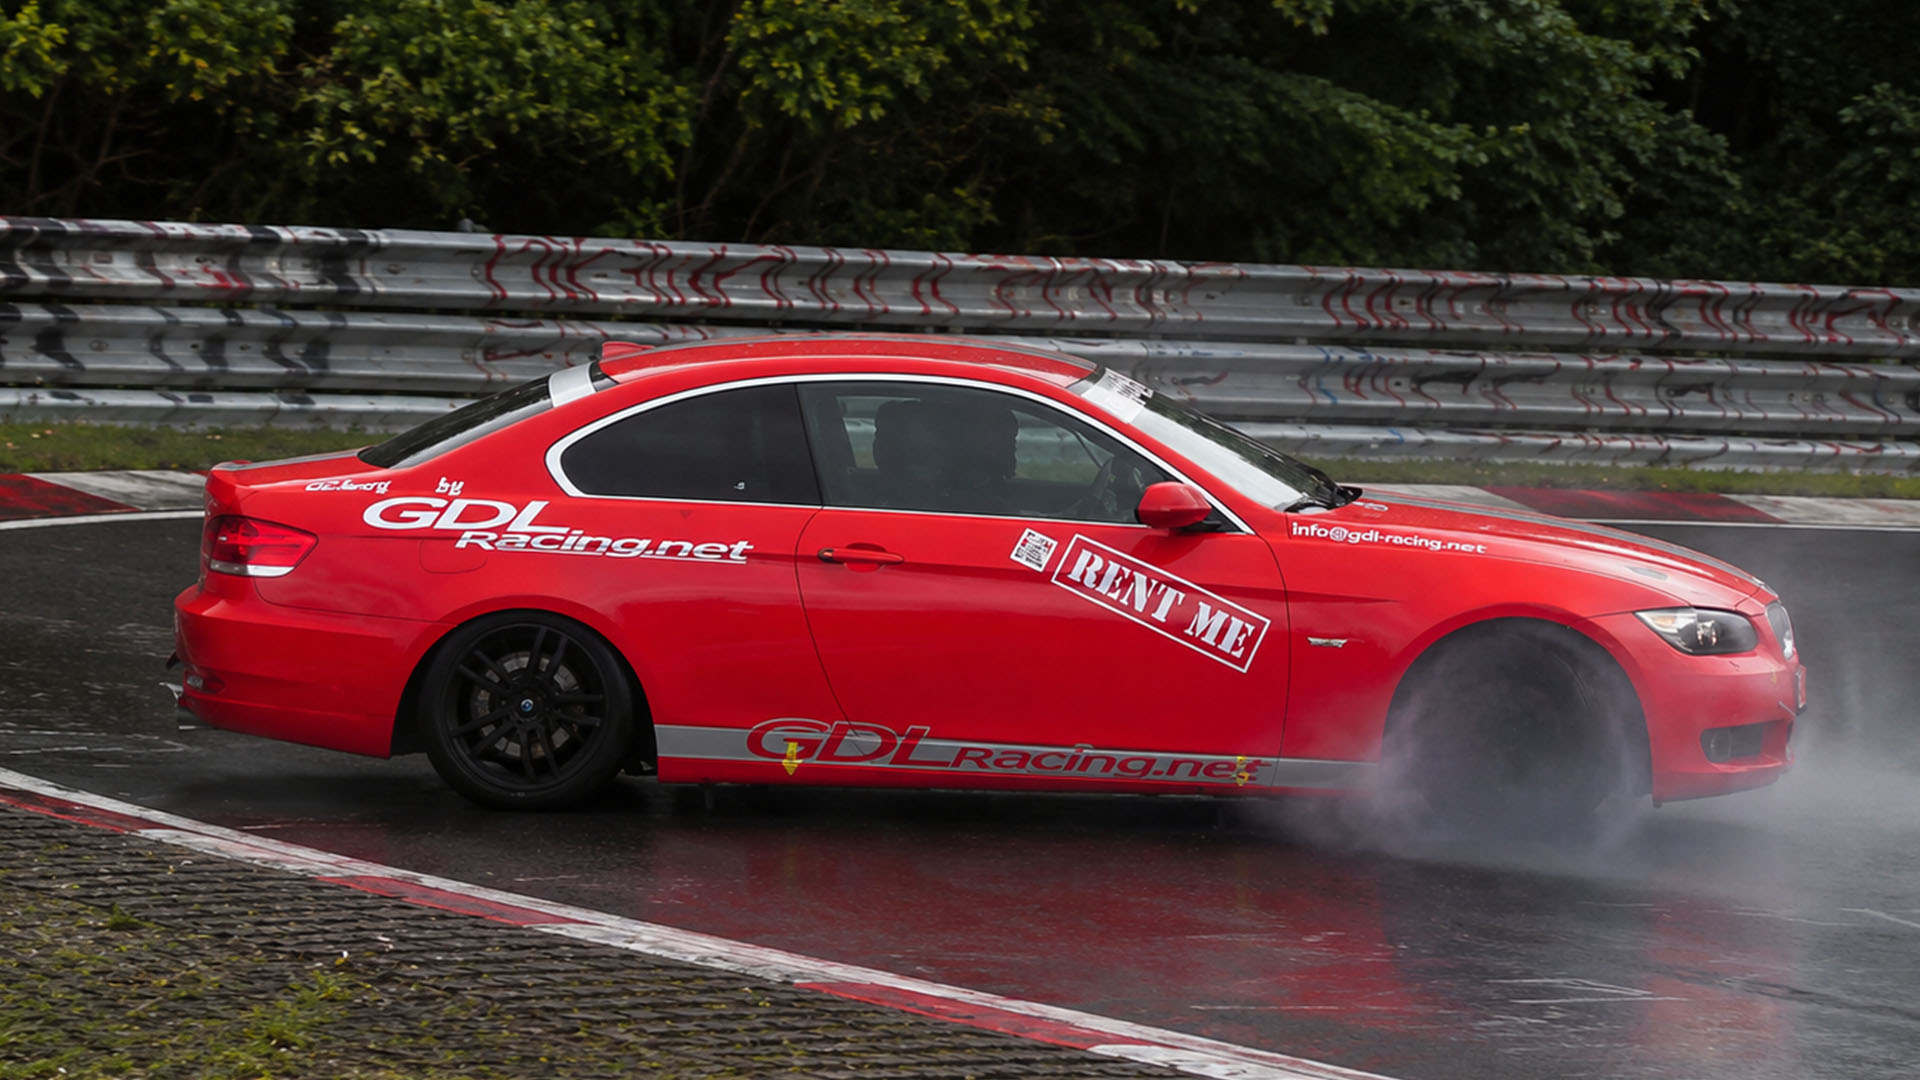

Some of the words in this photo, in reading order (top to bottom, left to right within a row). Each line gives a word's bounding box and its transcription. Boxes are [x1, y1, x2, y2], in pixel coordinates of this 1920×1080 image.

[435, 476, 464, 496] by
[363, 497, 570, 533] GDL
[455, 530, 754, 563] Racing.net
[1292, 522, 1487, 553] info@gdl-racing.net
[1067, 548, 1186, 622] RENT
[1184, 601, 1255, 658] ME
[746, 717, 952, 768] GDL
